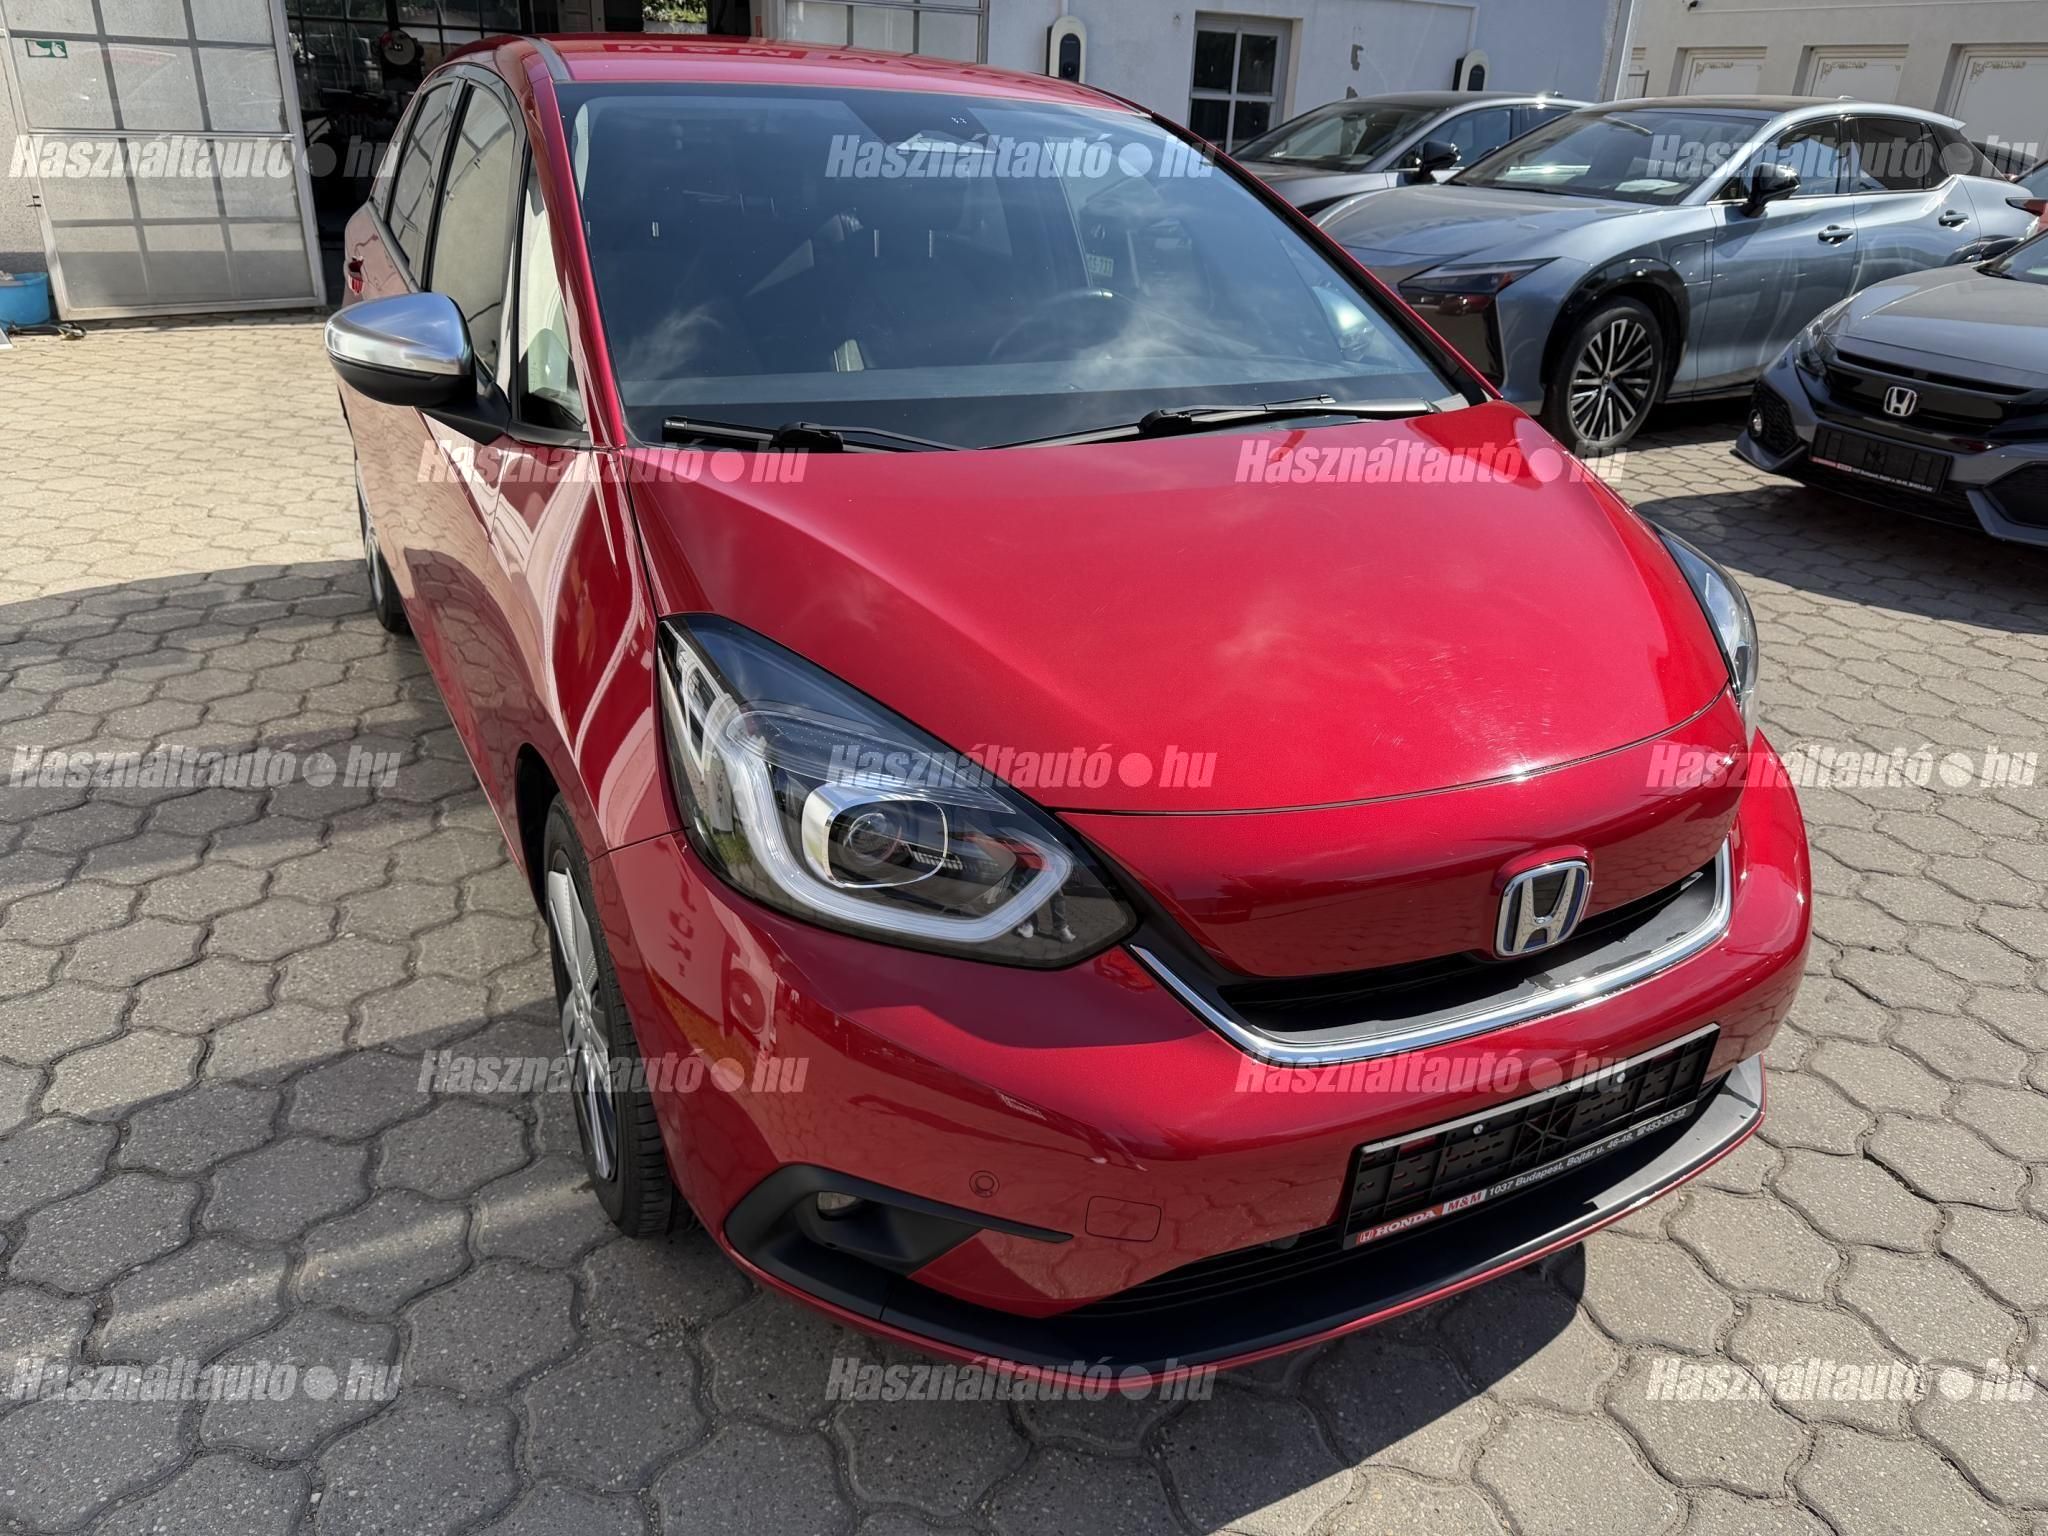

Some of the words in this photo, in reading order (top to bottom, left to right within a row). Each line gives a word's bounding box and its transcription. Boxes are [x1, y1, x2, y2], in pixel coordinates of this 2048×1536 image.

[1375, 1211, 1437, 1237] HONDA
[1447, 1191, 1483, 1213] M&M
[1489, 1181, 1513, 1197] 1037
